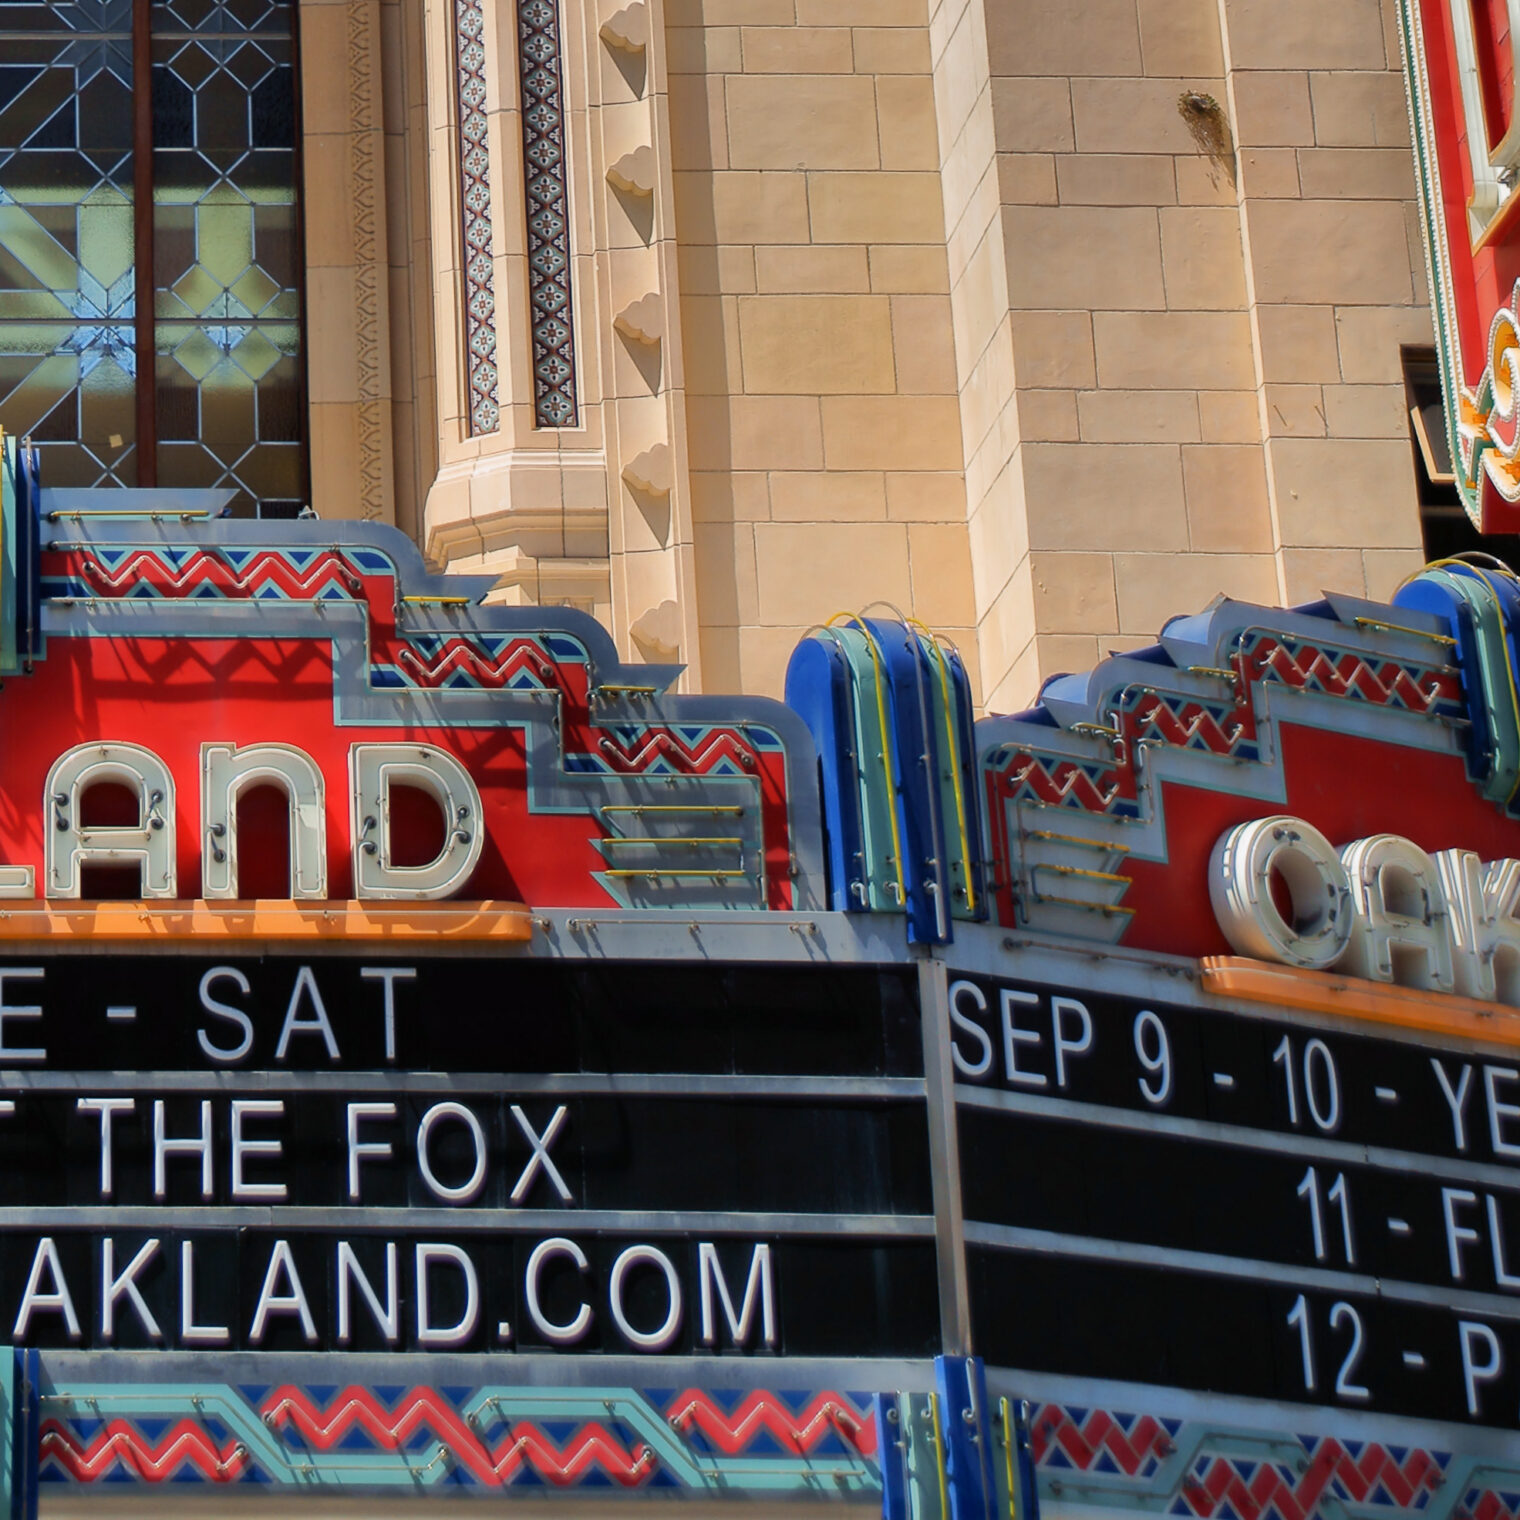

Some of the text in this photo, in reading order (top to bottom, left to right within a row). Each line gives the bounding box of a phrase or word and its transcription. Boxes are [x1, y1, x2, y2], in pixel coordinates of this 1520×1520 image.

[197, 966, 417, 1061] SAT
[948, 979, 1093, 1088] SEP
[1133, 1010, 1171, 1105] 9
[1272, 1034, 1340, 1132] 10
[76, 1097, 288, 1197] THE
[346, 1100, 573, 1201] FOX
[1296, 1165, 1354, 1264] 11
[1286, 1293, 1370, 1399] 12
